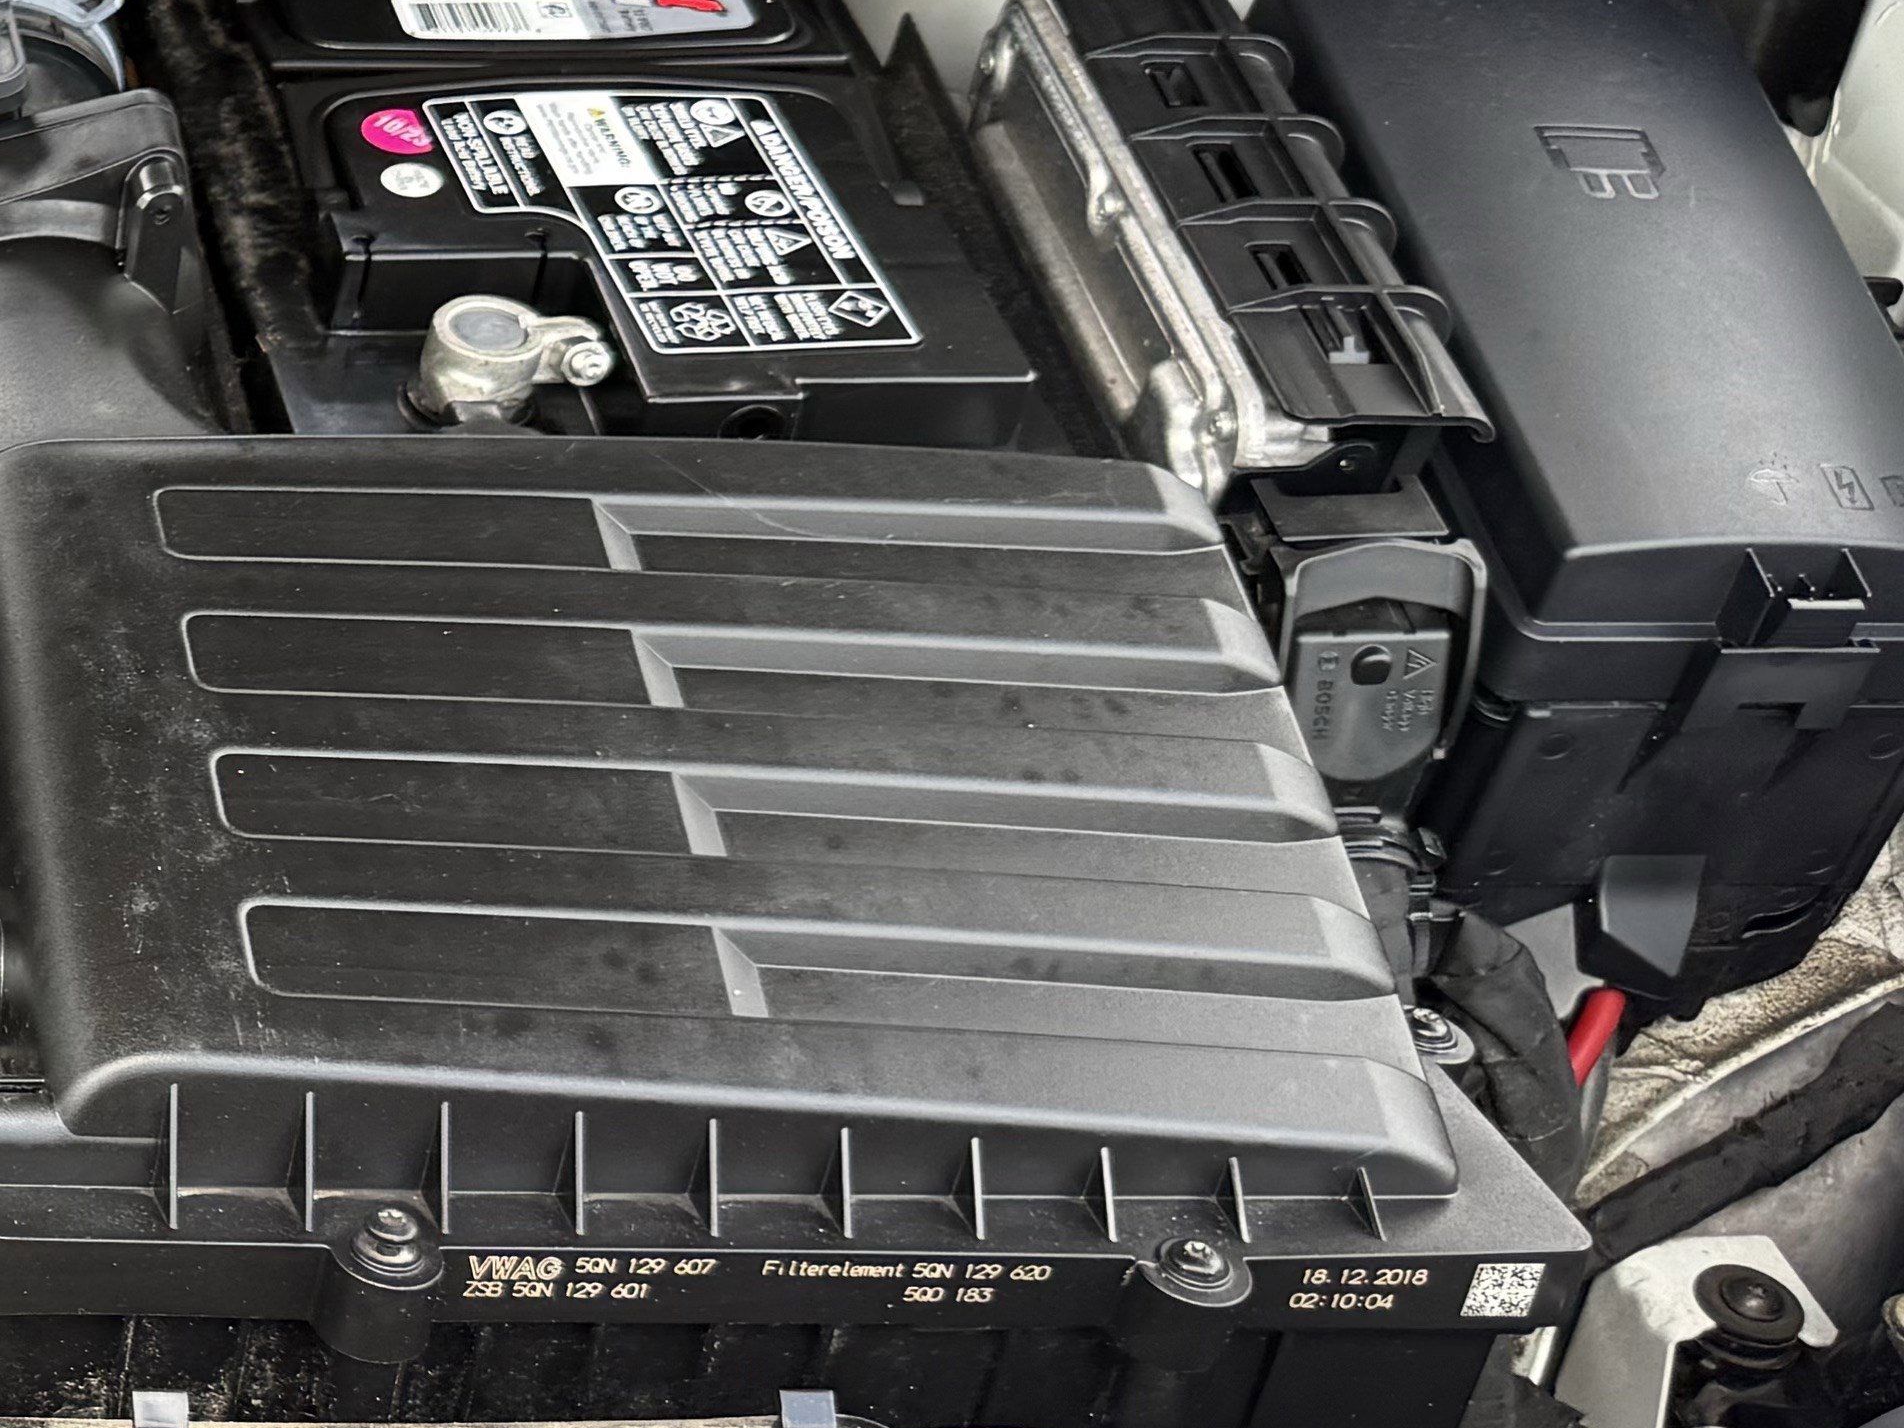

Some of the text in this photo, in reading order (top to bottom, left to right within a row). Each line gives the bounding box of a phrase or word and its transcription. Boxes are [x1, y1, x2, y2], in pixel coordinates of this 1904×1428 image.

[591, 119, 635, 167] WARNING:
[1312, 678, 1334, 740] BOSCH
[469, 1256, 562, 1280] VWAG
[628, 1258, 666, 1274] 129
[674, 1259, 717, 1275] 607
[762, 1260, 904, 1277] Filterelement
[965, 1264, 1002, 1280] 129
[1009, 1265, 1051, 1280] 620
[463, 1281, 503, 1297] ZSB
[566, 1283, 604, 1298] 129
[610, 1283, 648, 1299] 601
[956, 1287, 994, 1303] 183
[1289, 1293, 1394, 1309] 02:10:04
